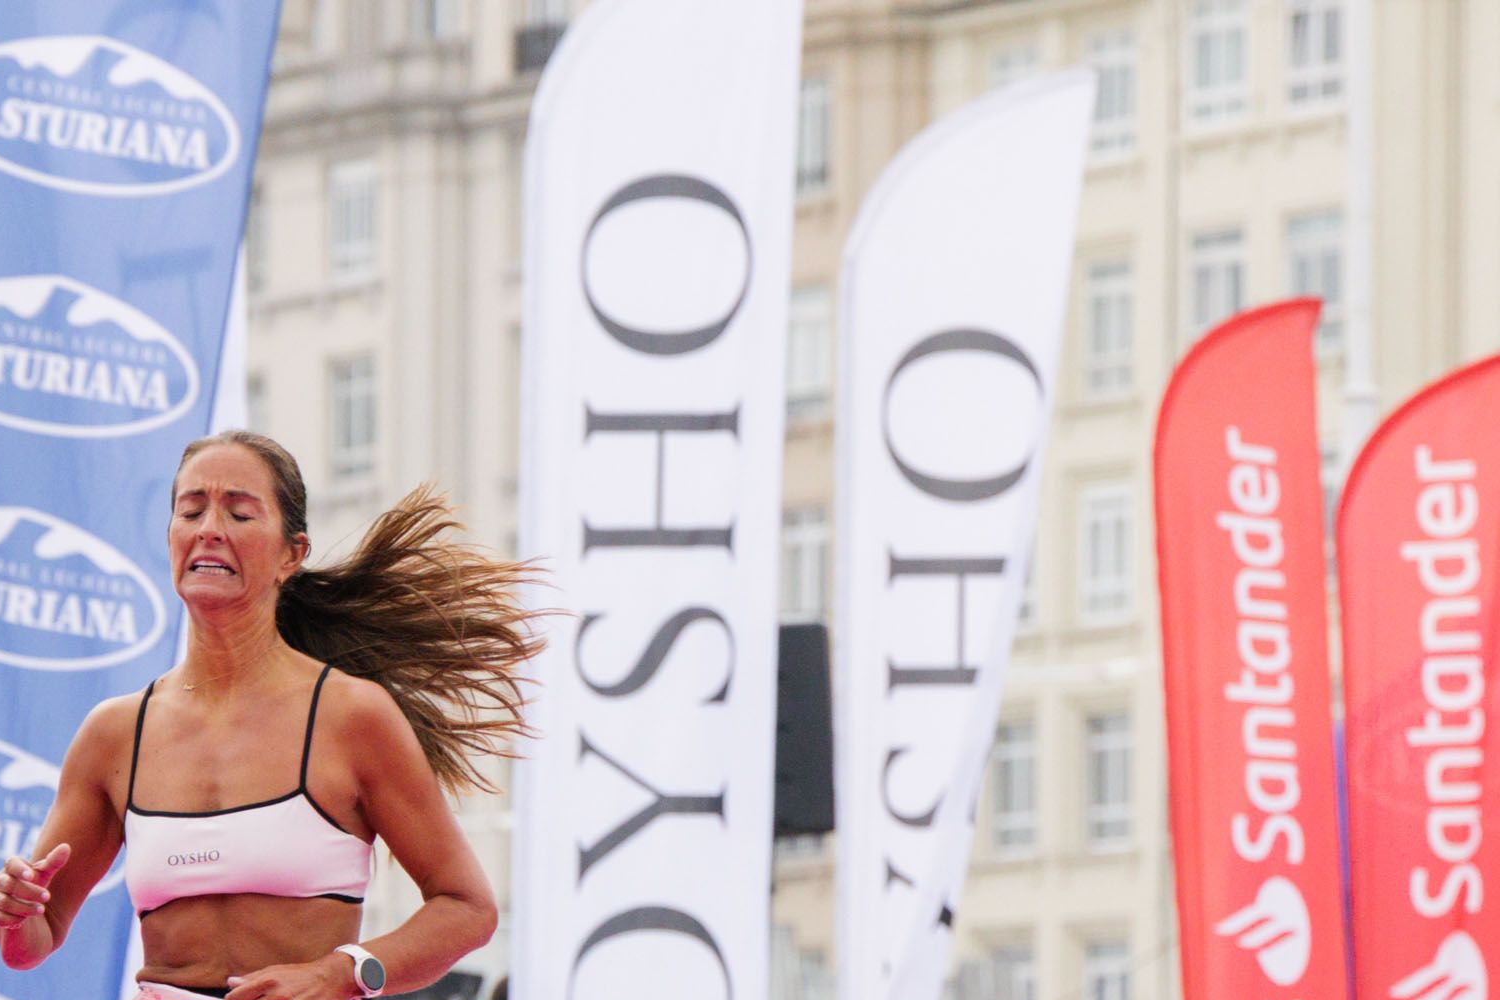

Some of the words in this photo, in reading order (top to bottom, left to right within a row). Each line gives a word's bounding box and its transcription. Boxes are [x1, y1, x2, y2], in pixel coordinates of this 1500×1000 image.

[167, 850, 220, 867] OYSHO
[1216, 426, 1305, 866] Santander
[1401, 443, 1487, 918] Santander
